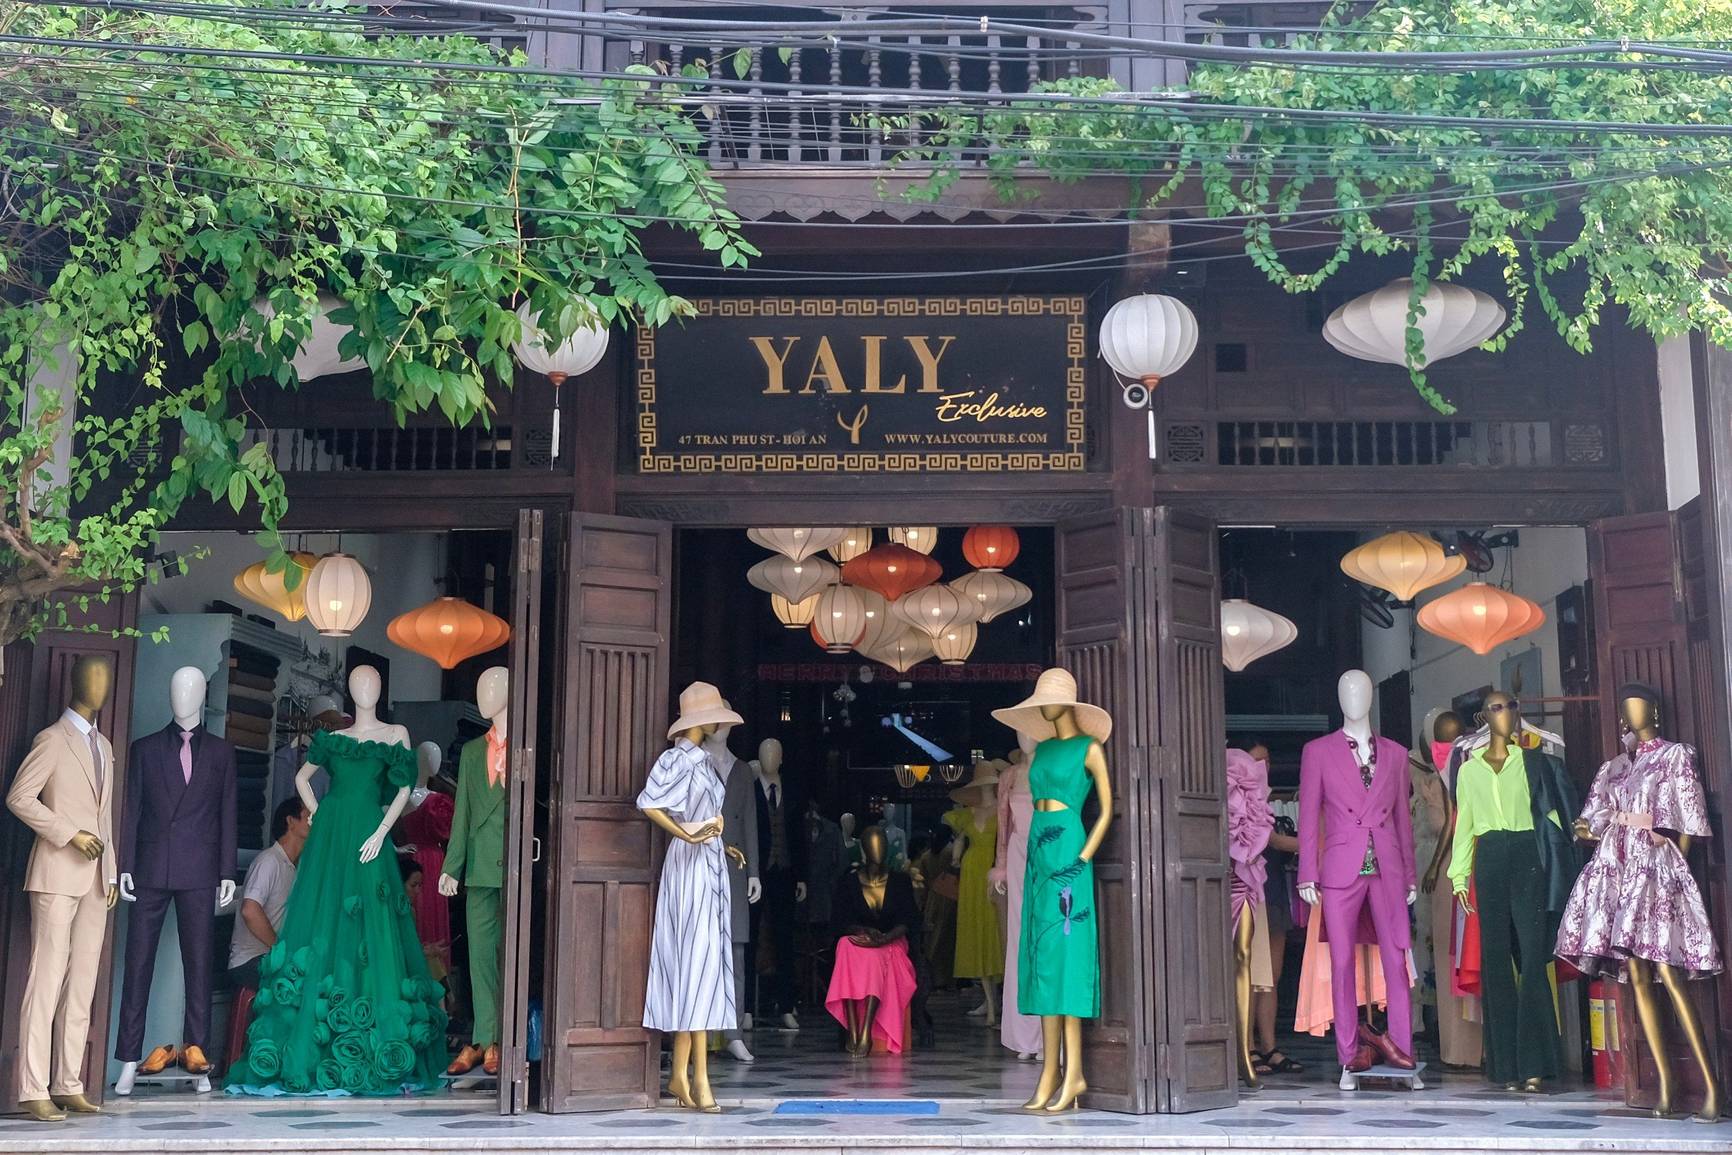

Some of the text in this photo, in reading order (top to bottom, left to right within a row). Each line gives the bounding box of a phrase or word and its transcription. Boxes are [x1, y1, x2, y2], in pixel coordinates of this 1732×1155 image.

[748, 335, 957, 395] YALY
[935, 390, 1048, 424] Exclusive
[678, 434, 691, 445] 47
[694, 434, 728, 445] TRAN
[732, 434, 758, 445] PHU
[809, 434, 826, 445] AN
[884, 433, 1048, 445] WWW.YALYCOUTURE.COM
